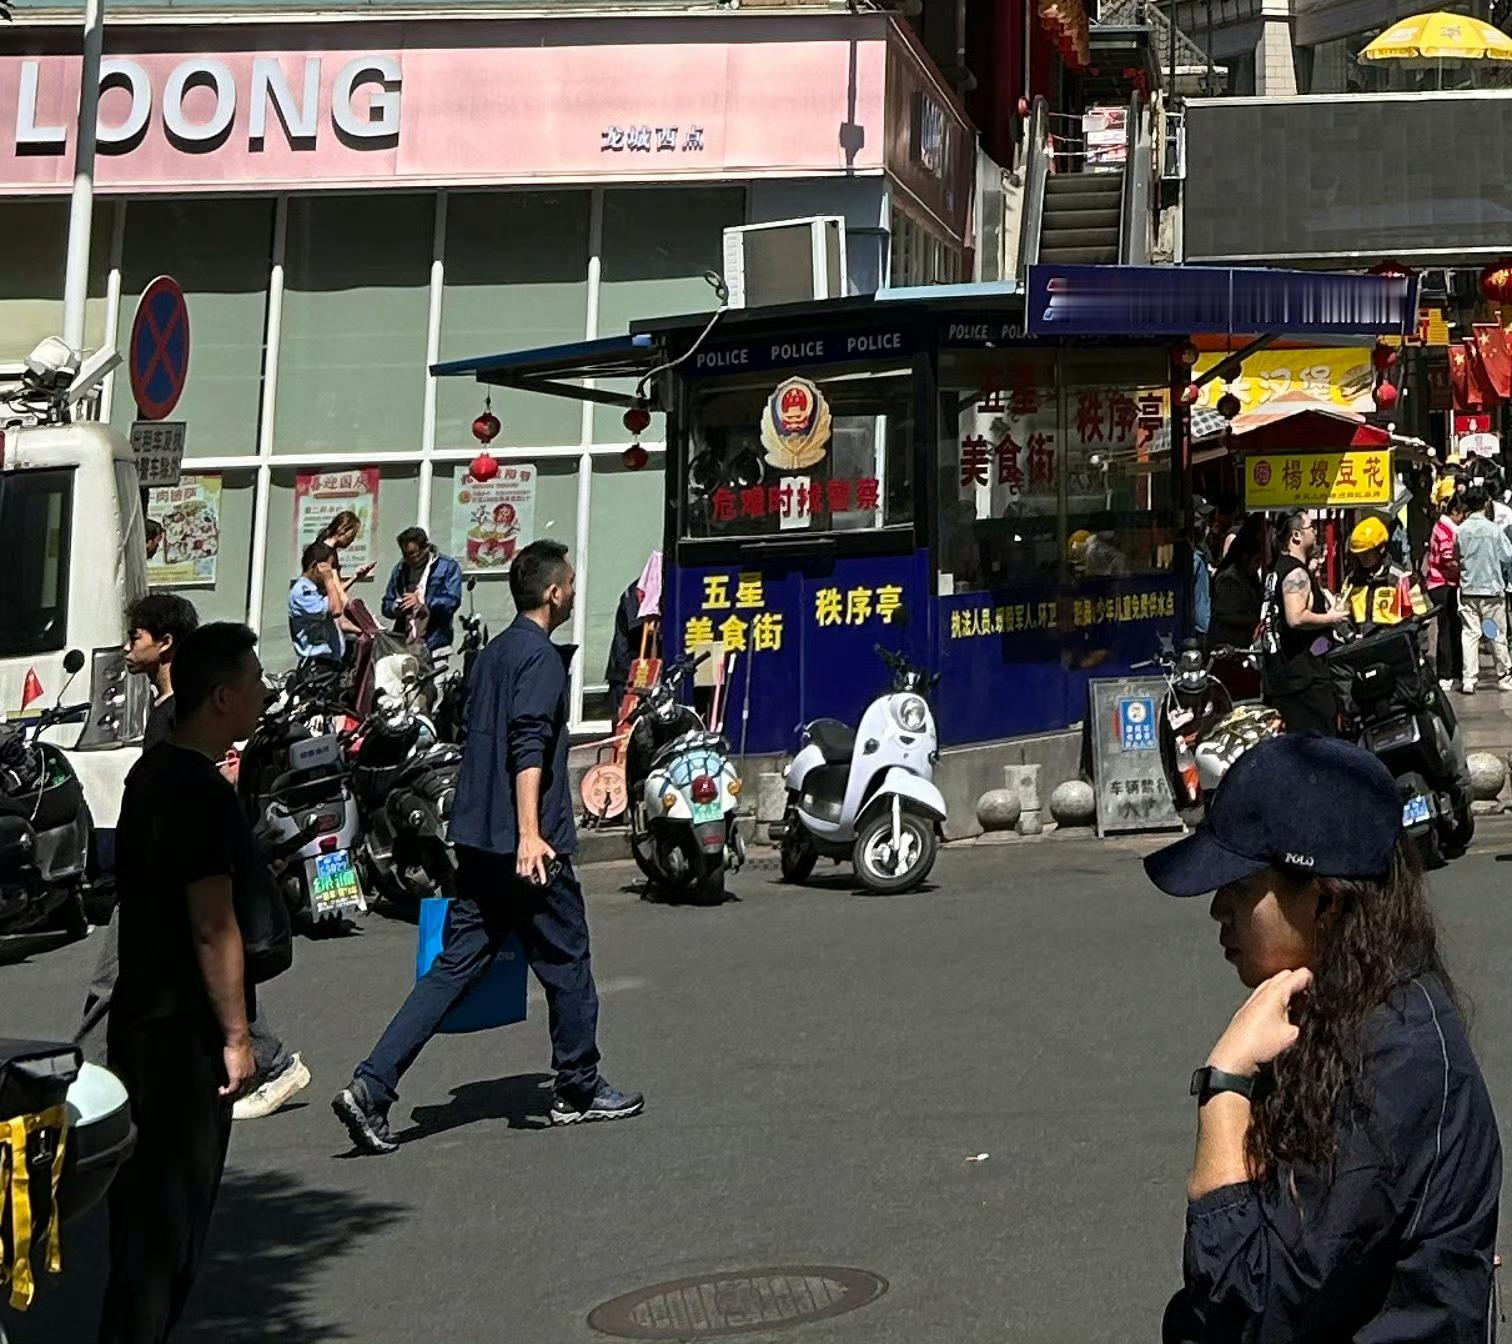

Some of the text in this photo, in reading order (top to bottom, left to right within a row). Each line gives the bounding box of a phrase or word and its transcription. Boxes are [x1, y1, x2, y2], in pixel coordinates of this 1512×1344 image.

[15, 54, 403, 148] LOONG
[601, 123, 705, 152] 龙城西点
[697, 332, 902, 368] POLICE POLICE POLICE
[949, 324, 988, 340] POLICE
[960, 433, 1055, 487] 美食街
[712, 478, 880, 523] 危难时找警察
[702, 571, 765, 610] 五星
[815, 584, 903, 627] 秩序亭
[684, 613, 783, 655] 美食街
